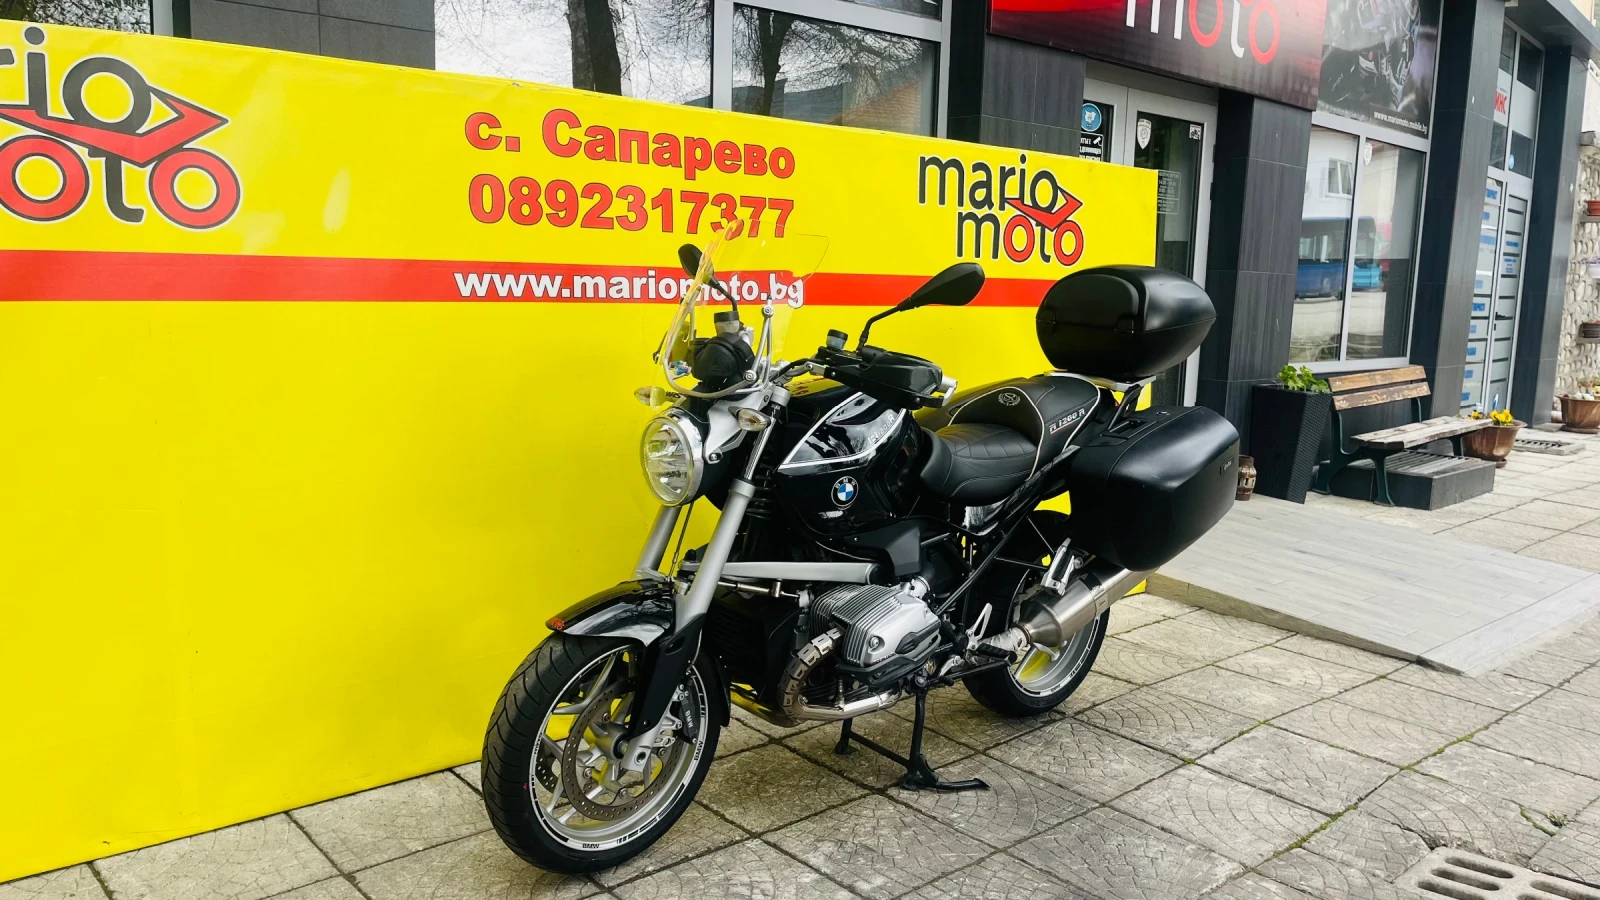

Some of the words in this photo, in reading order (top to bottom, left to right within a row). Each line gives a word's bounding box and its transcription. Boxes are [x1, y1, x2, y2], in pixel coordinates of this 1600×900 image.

[0, 26, 152, 137] io
[465, 112, 520, 152] с.
[542, 109, 795, 180] Сапарево
[468, 173, 795, 241] 0892317377
[918, 153, 1059, 214] mario
[956, 211, 1084, 266] moto
[453, 269, 805, 309] www.mariomoto.bg
[685, 710, 694, 728] BMW
[694, 740, 704, 761] BMW
